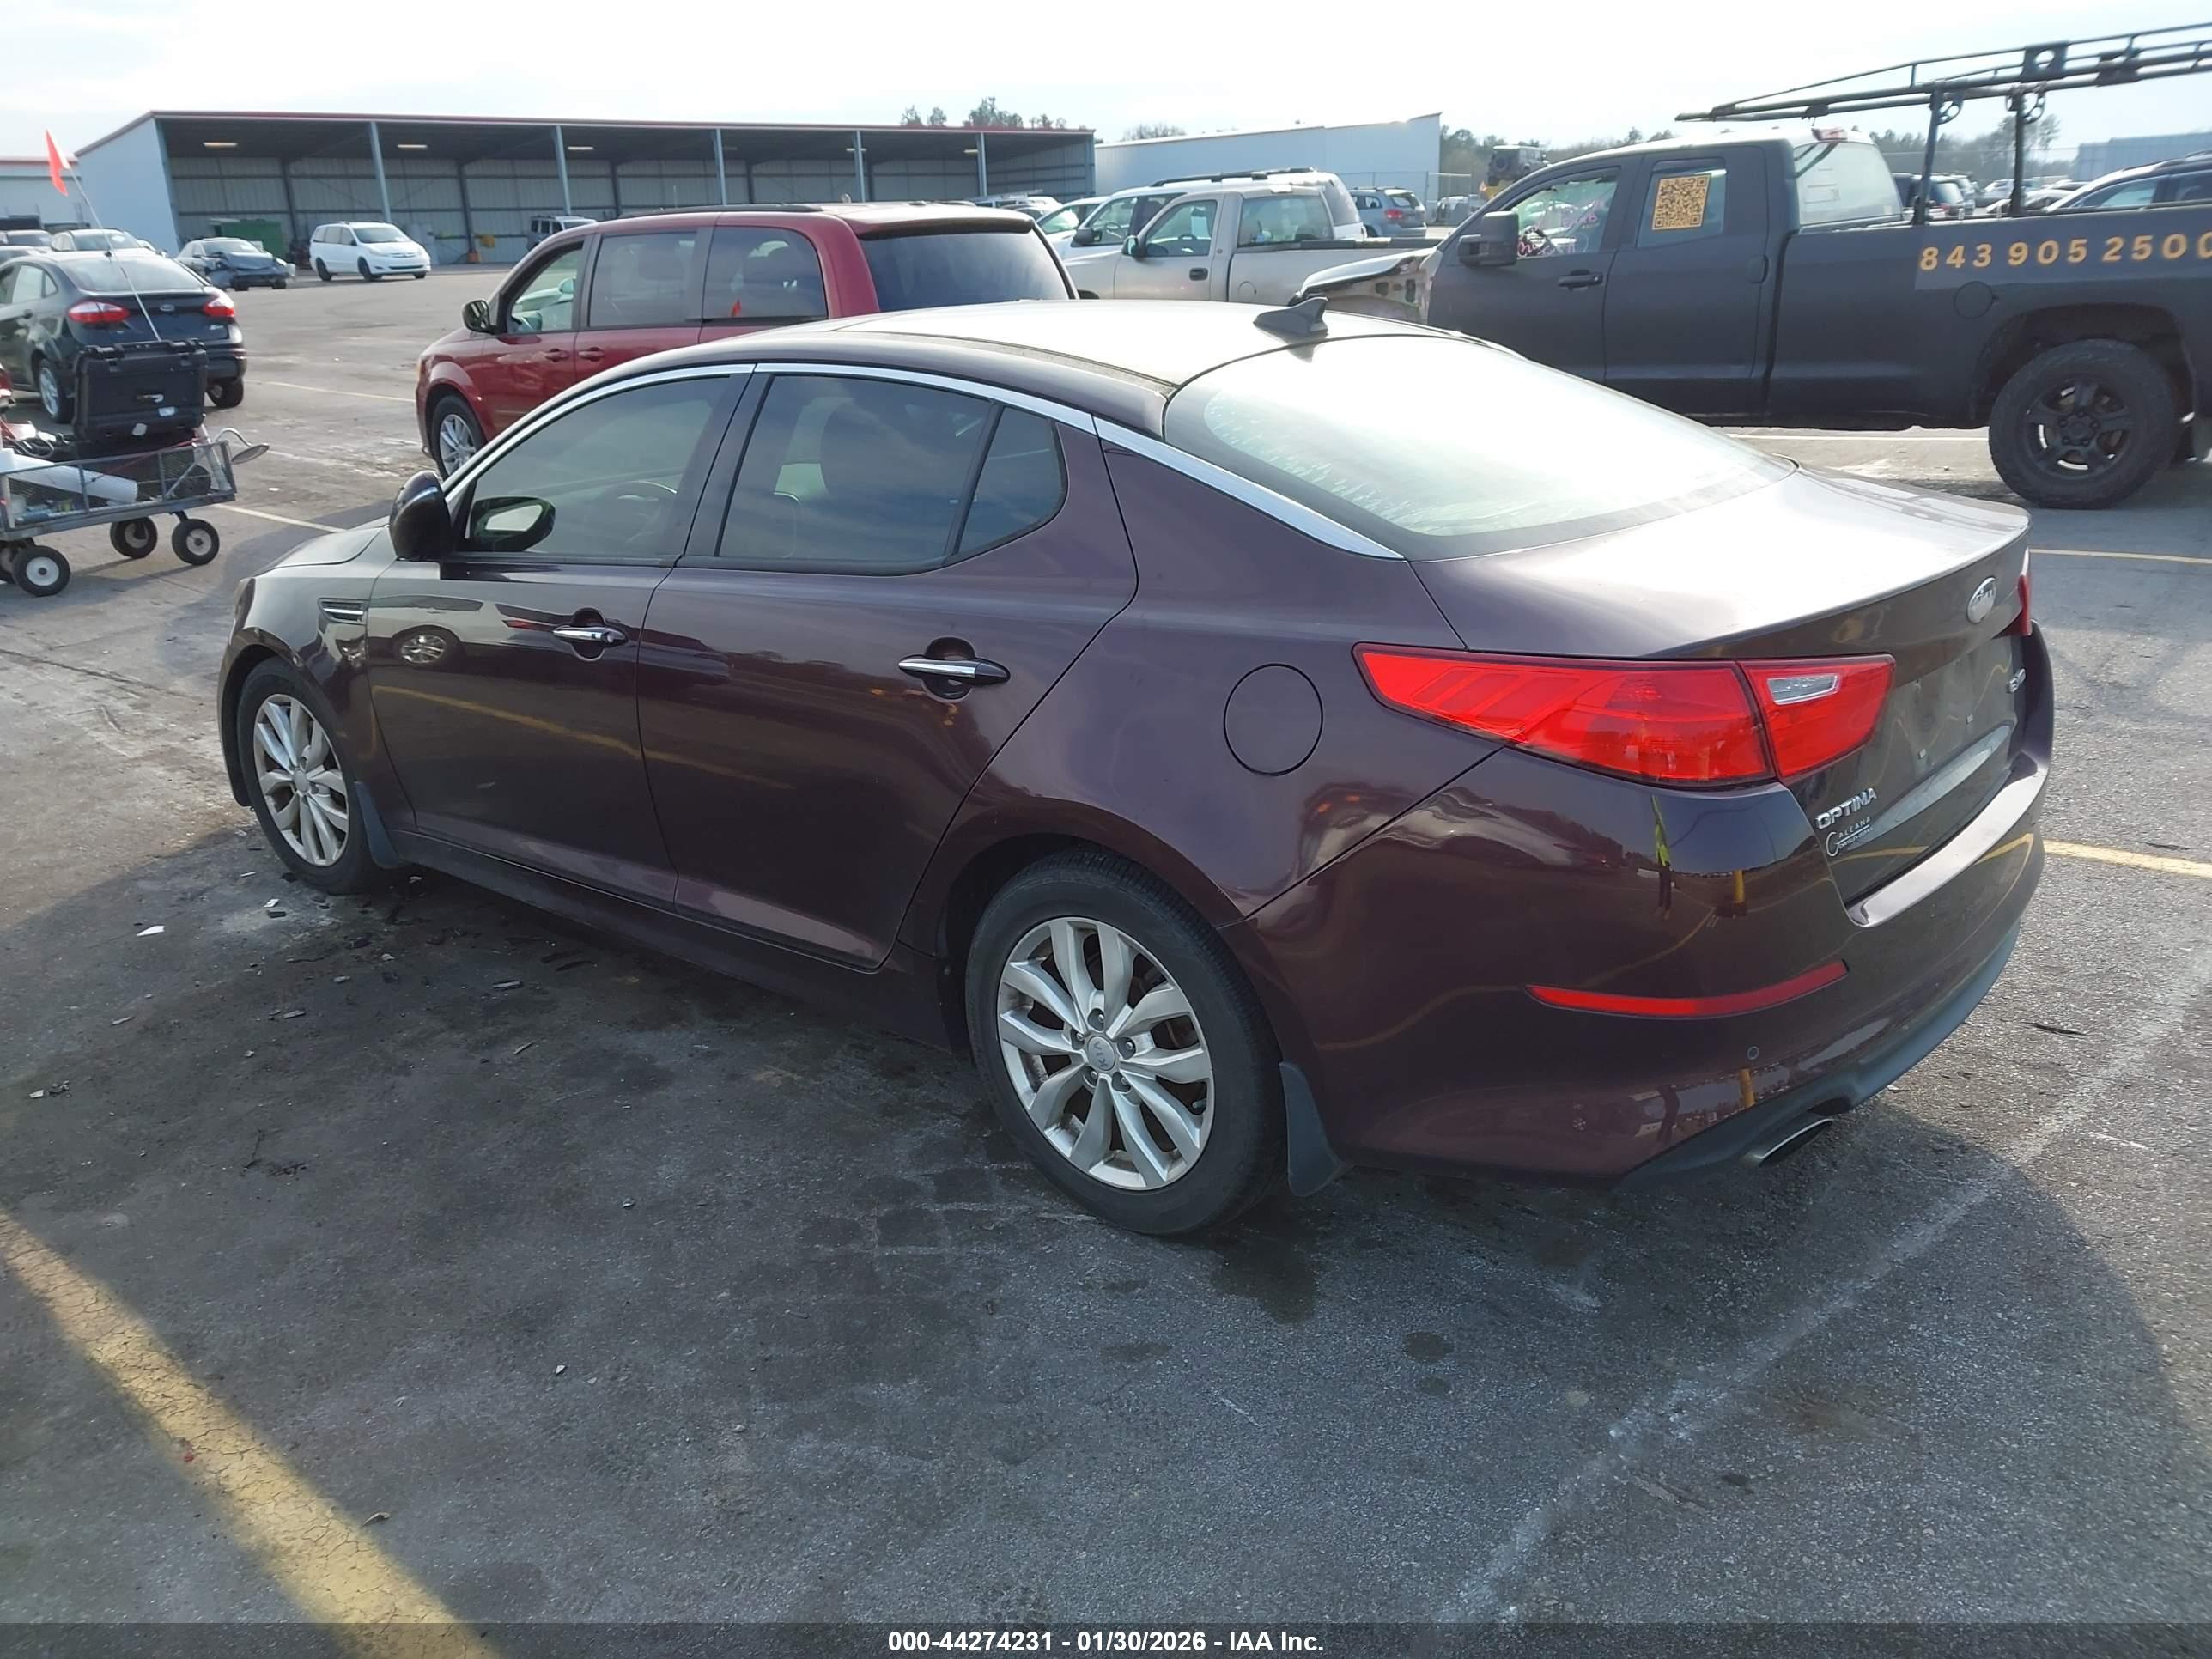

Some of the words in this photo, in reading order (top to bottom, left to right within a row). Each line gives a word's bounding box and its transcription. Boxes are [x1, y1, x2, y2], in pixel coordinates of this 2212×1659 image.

[1918, 243, 1993, 271] 843
[2008, 238, 2088, 267] 905
[1816, 787, 1877, 830] OPTIMA
[1093, 1041, 1109, 1067] KIA
